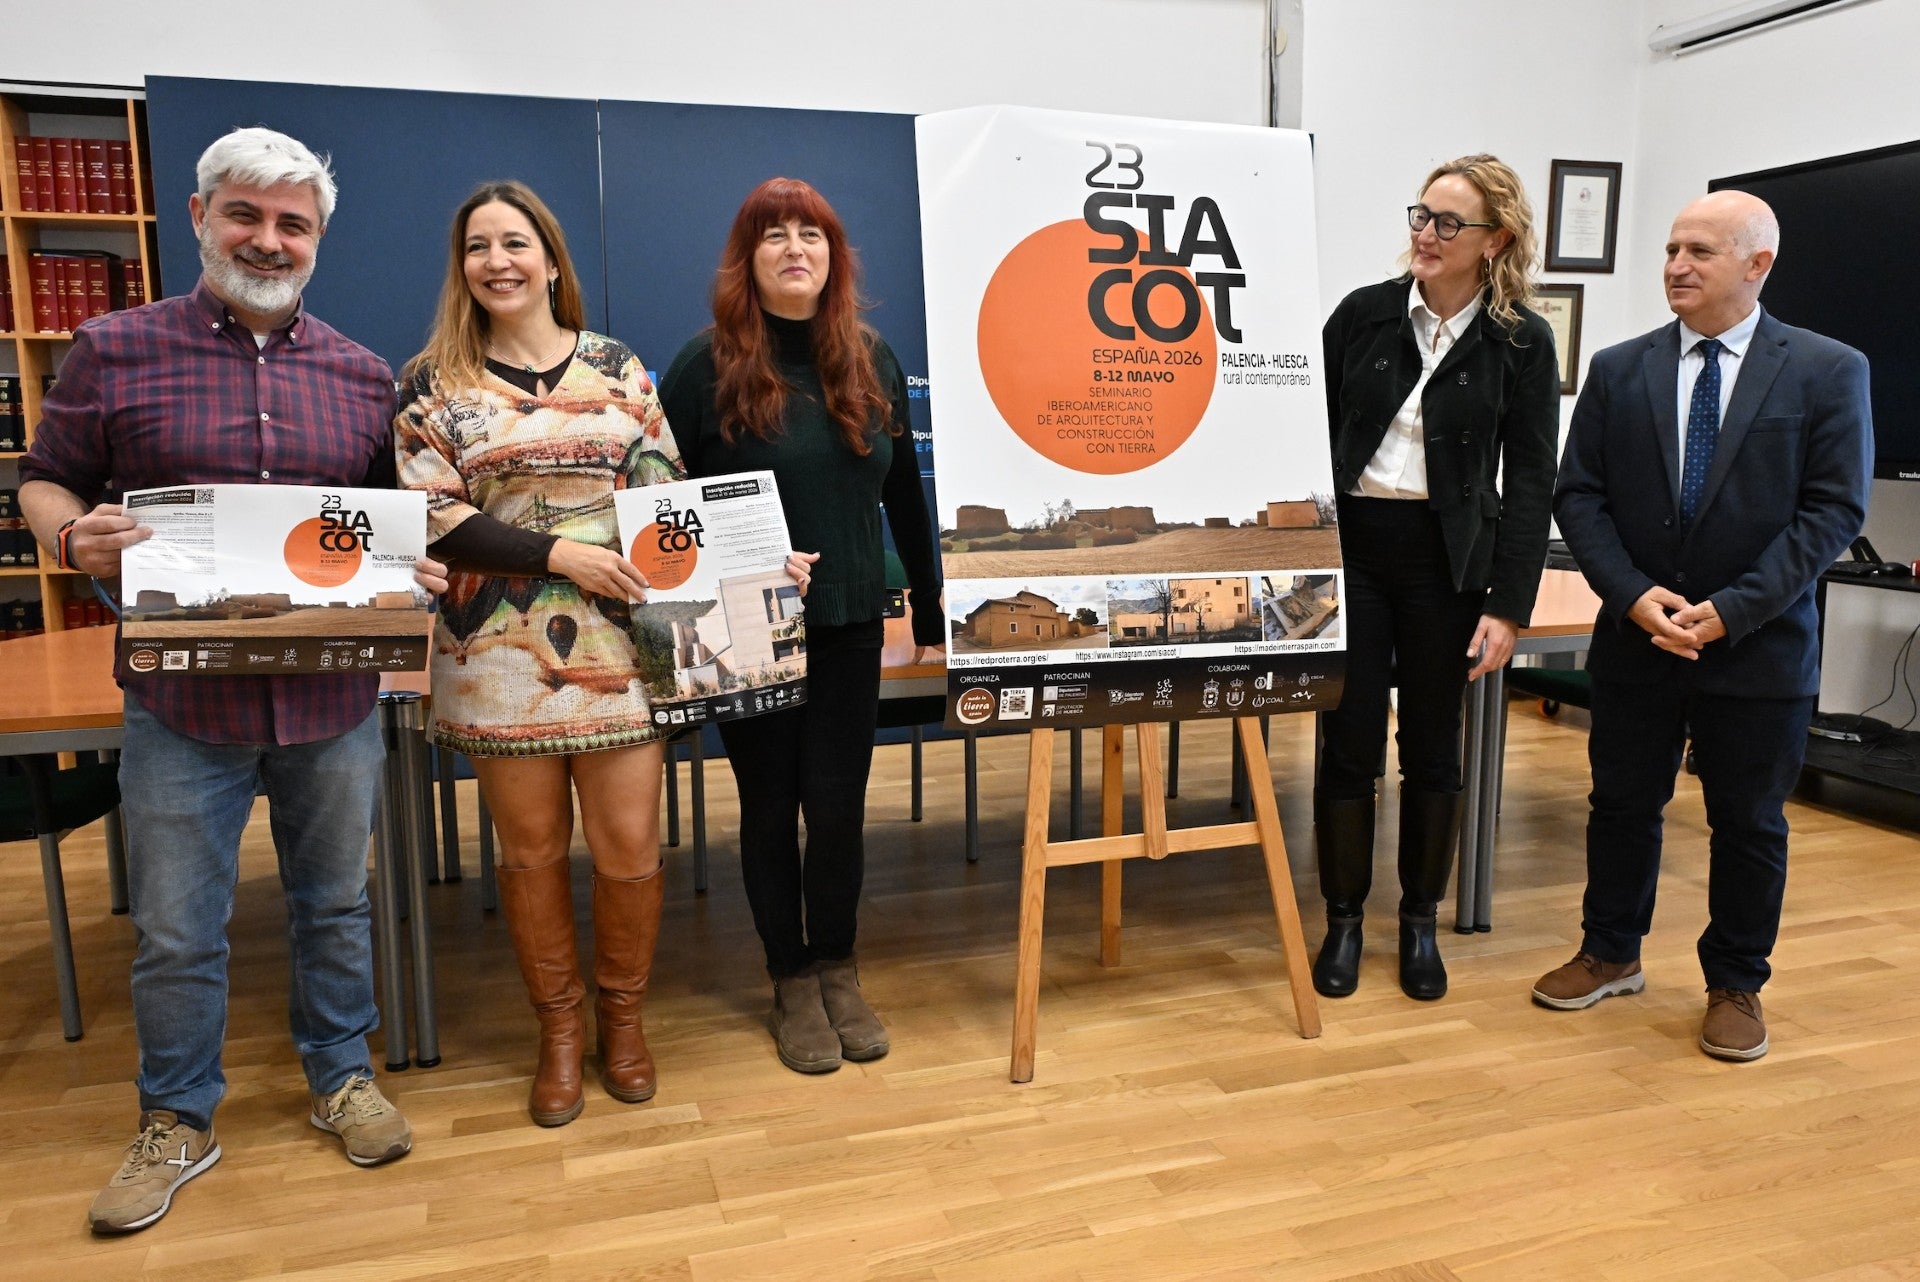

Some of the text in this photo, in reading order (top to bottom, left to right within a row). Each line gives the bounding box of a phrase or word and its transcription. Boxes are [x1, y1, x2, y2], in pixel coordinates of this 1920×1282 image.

[1085, 140, 1144, 190] 23
[1083, 191, 1242, 269] SIA
[1087, 268, 1246, 344] COT
[1092, 347, 1203, 366] ESPAÑA 2026
[1222, 353, 1266, 368] PALENCIA
[1272, 354, 1309, 369] HUESCA
[1093, 370, 1174, 383] 8-12 MAYO
[1223, 371, 1311, 388] rural contemporáneo
[908, 390, 922, 398] DE
[1088, 387, 1152, 398] SEMINARIO
[1047, 400, 1153, 412] IBEROAMERICANO
[1037, 414, 1154, 426] DE ARQUITECTURA Y
[1056, 426, 1154, 440] CONSTRUCCIÓN
[1086, 443, 1156, 454] CON TIERRA
[321, 495, 342, 509] 23
[654, 498, 672, 513] 23
[320, 510, 372, 531] SIA
[656, 509, 702, 534] SIA
[320, 531, 374, 552] COT
[658, 528, 704, 552] COT
[1234, 641, 1337, 654] https://madeintierraspain.com/
[950, 653, 1049, 666] https://redproterra.org/es/
[1208, 664, 1250, 672] COLABORAN
[960, 674, 1000, 684] ORGANIZA
[1044, 672, 1091, 681] PATROCINAN
[963, 701, 990, 710] tierra
